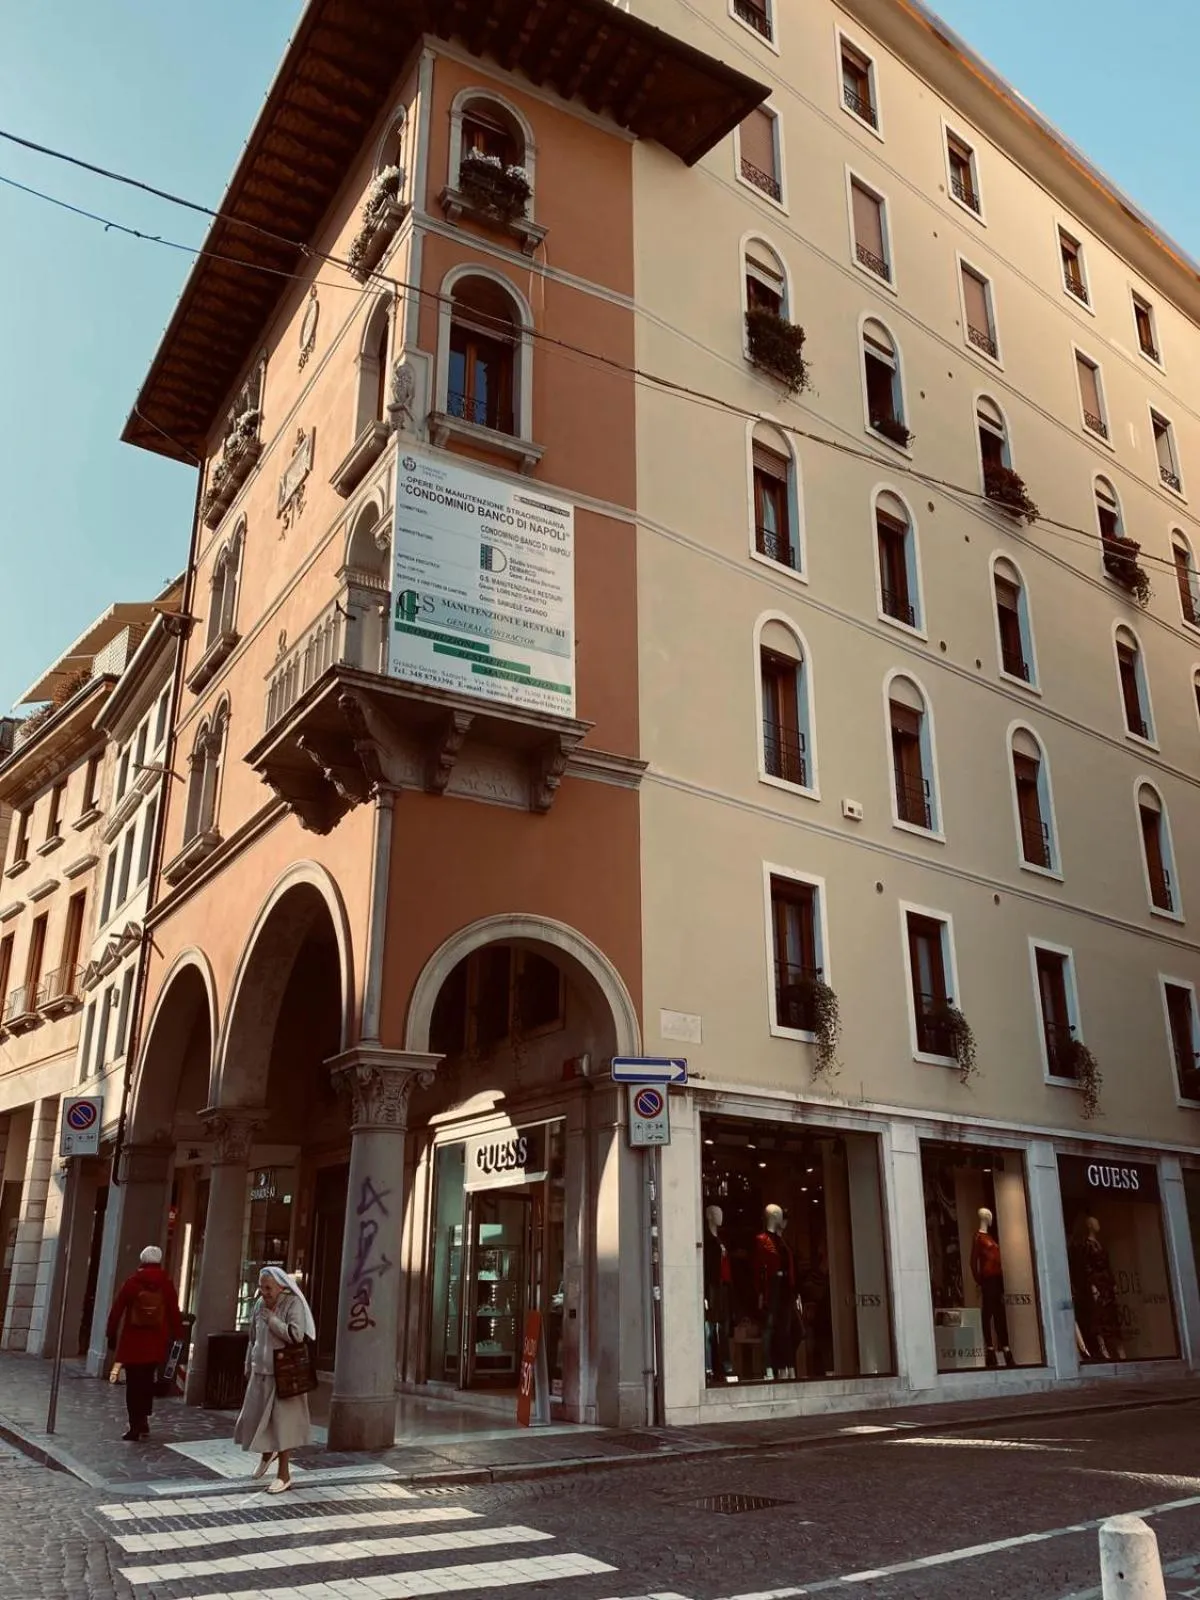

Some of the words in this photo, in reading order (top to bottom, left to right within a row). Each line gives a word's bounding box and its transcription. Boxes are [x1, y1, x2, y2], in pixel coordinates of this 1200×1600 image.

[406, 476, 434, 491] OPERE
[436, 484, 444, 493] DI
[445, 487, 505, 511] MANUTENZIONE
[506, 504, 566, 530] STRAORDINARIA
[477, 507, 514, 526] BANCO
[516, 517, 527, 529] DI
[480, 524, 520, 542] CONDOMINIO
[520, 536, 542, 549] BANCO
[549, 545, 571, 558] NAPOLI
[442, 599, 513, 626] MANUTENZIONI
[521, 619, 566, 638] RESTAURI
[446, 617, 482, 634] GENERAL
[484, 626, 536, 645] CONTRACTOR
[476, 1136, 528, 1172] GUESS
[1087, 1163, 1140, 1190] GUESS
